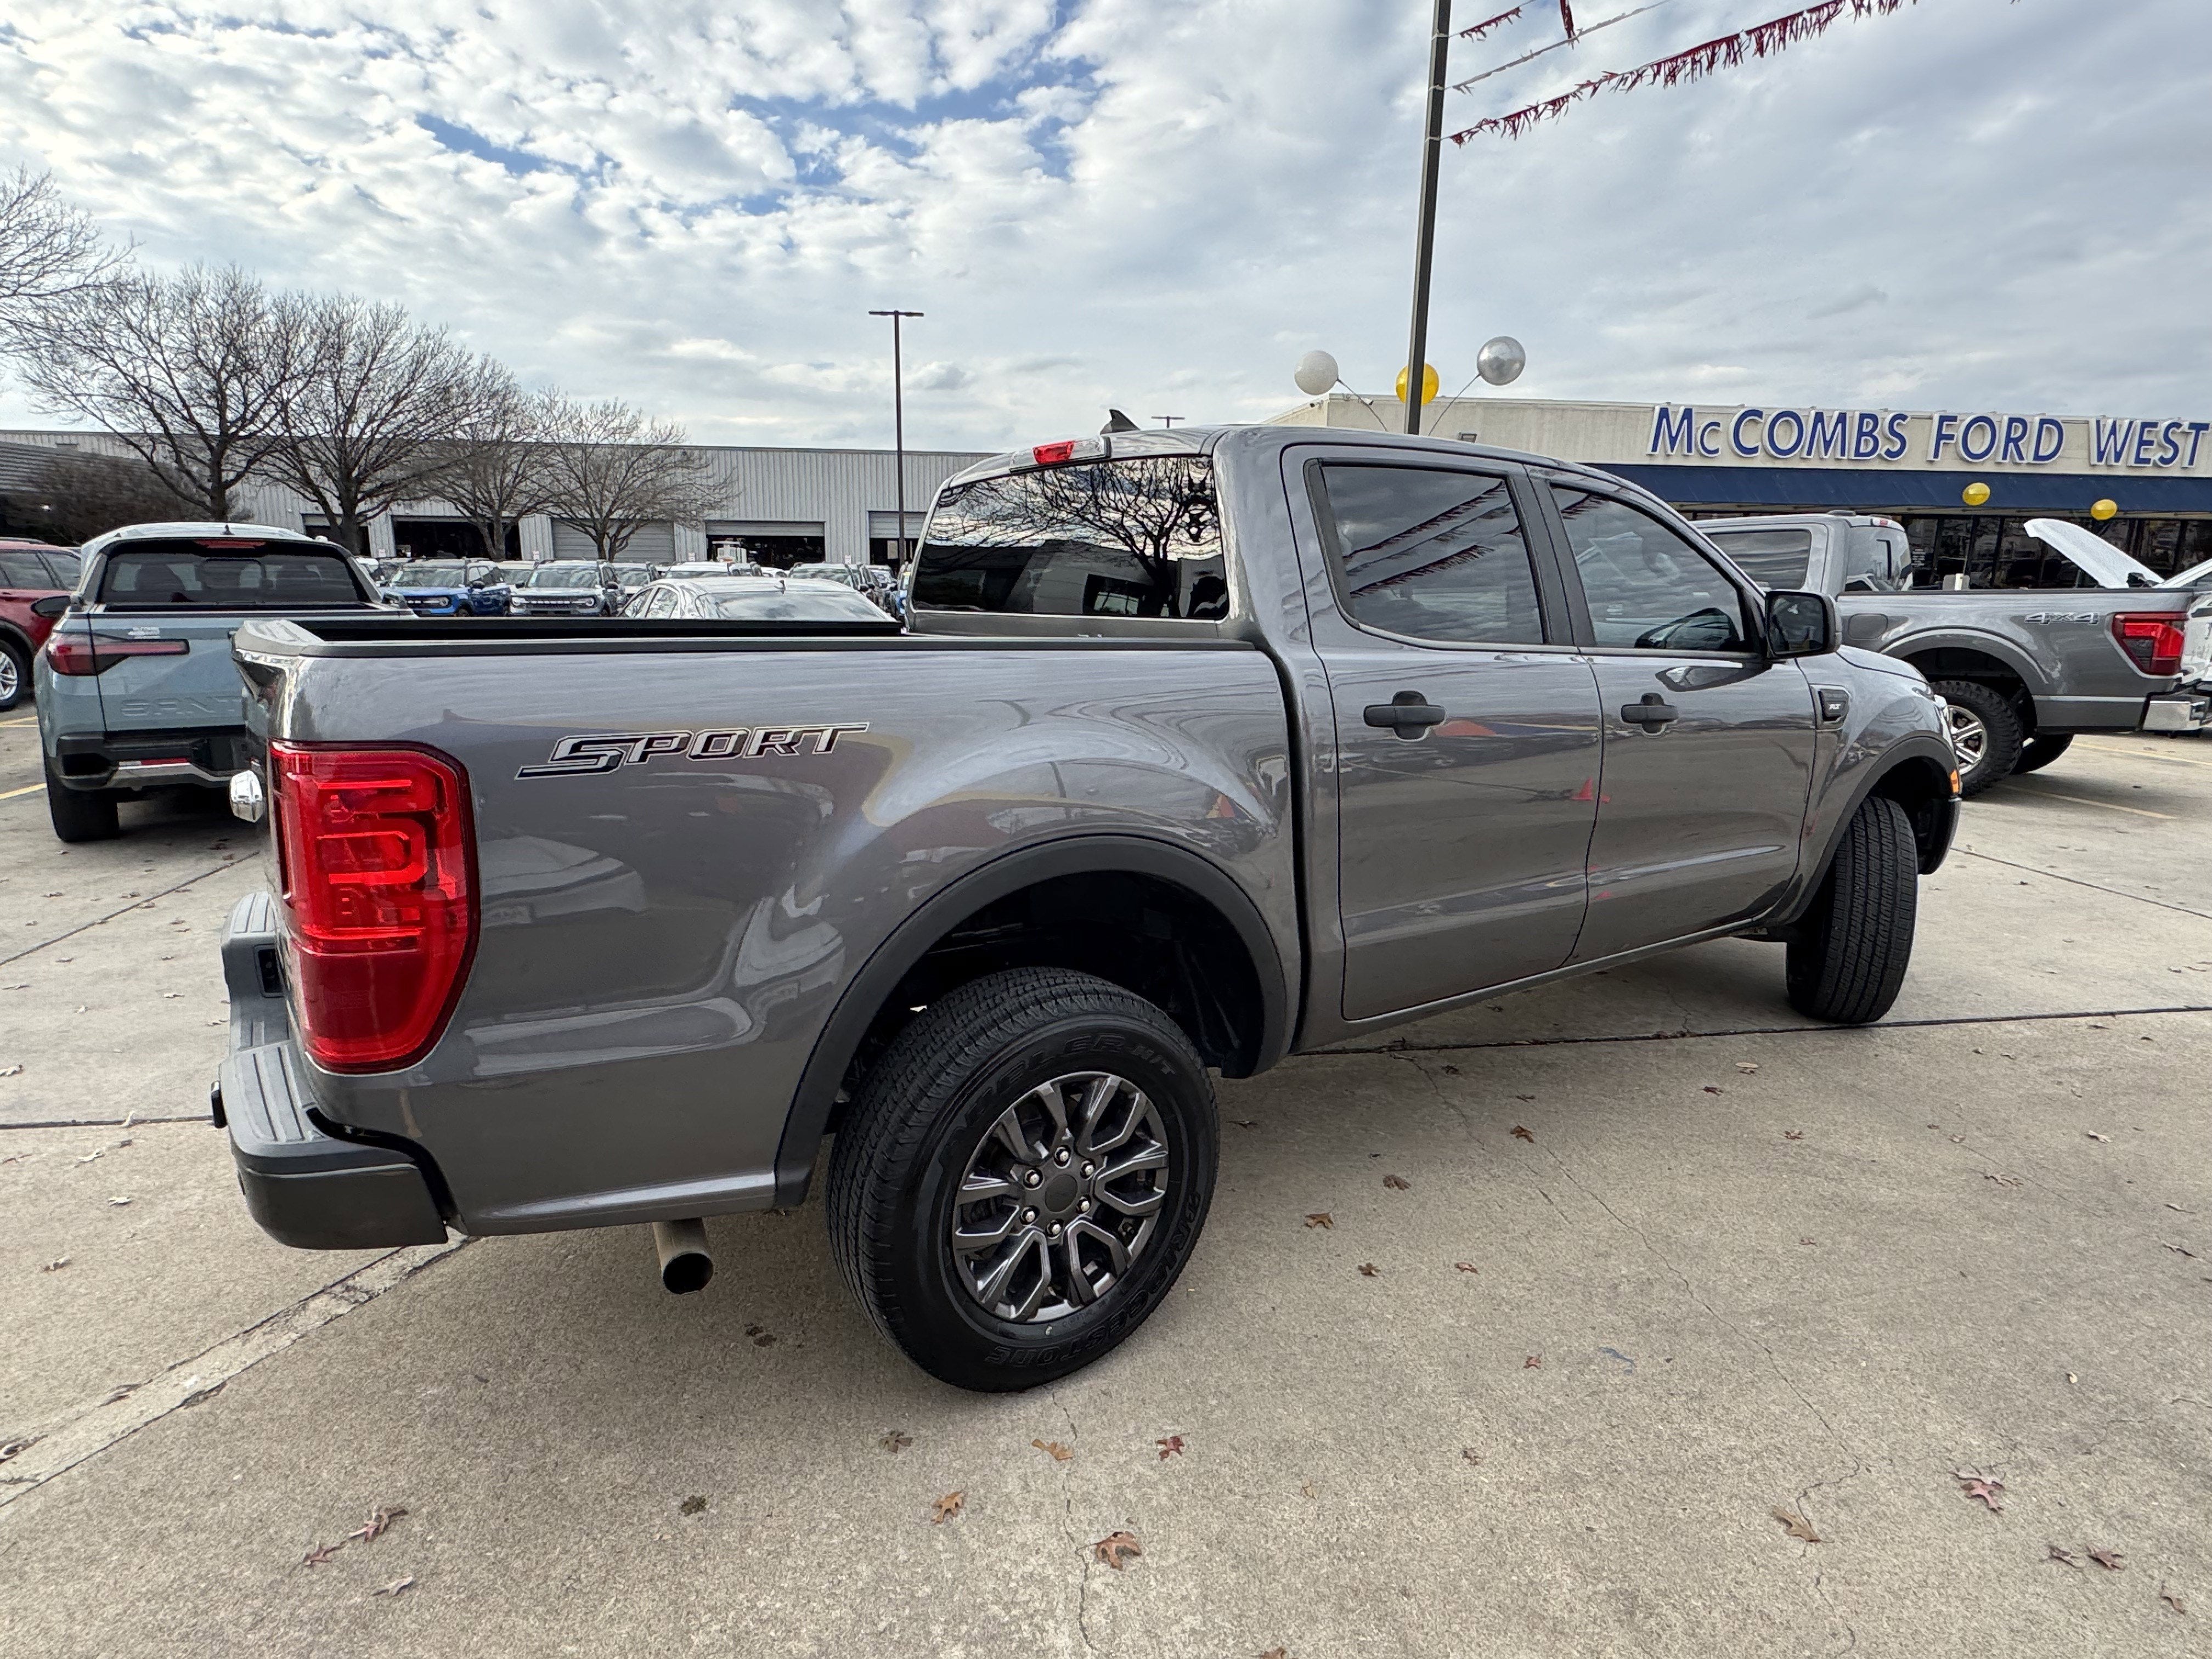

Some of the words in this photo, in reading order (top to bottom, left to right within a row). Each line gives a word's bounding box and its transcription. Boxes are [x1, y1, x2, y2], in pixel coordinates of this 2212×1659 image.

[1927, 414, 2065, 464] FORD
[2089, 417, 2211, 468] WEST
[122, 696, 242, 716] SANT
[515, 721, 870, 780] SPORT
[984, 1191, 1201, 1368] BRIDGESTONE
